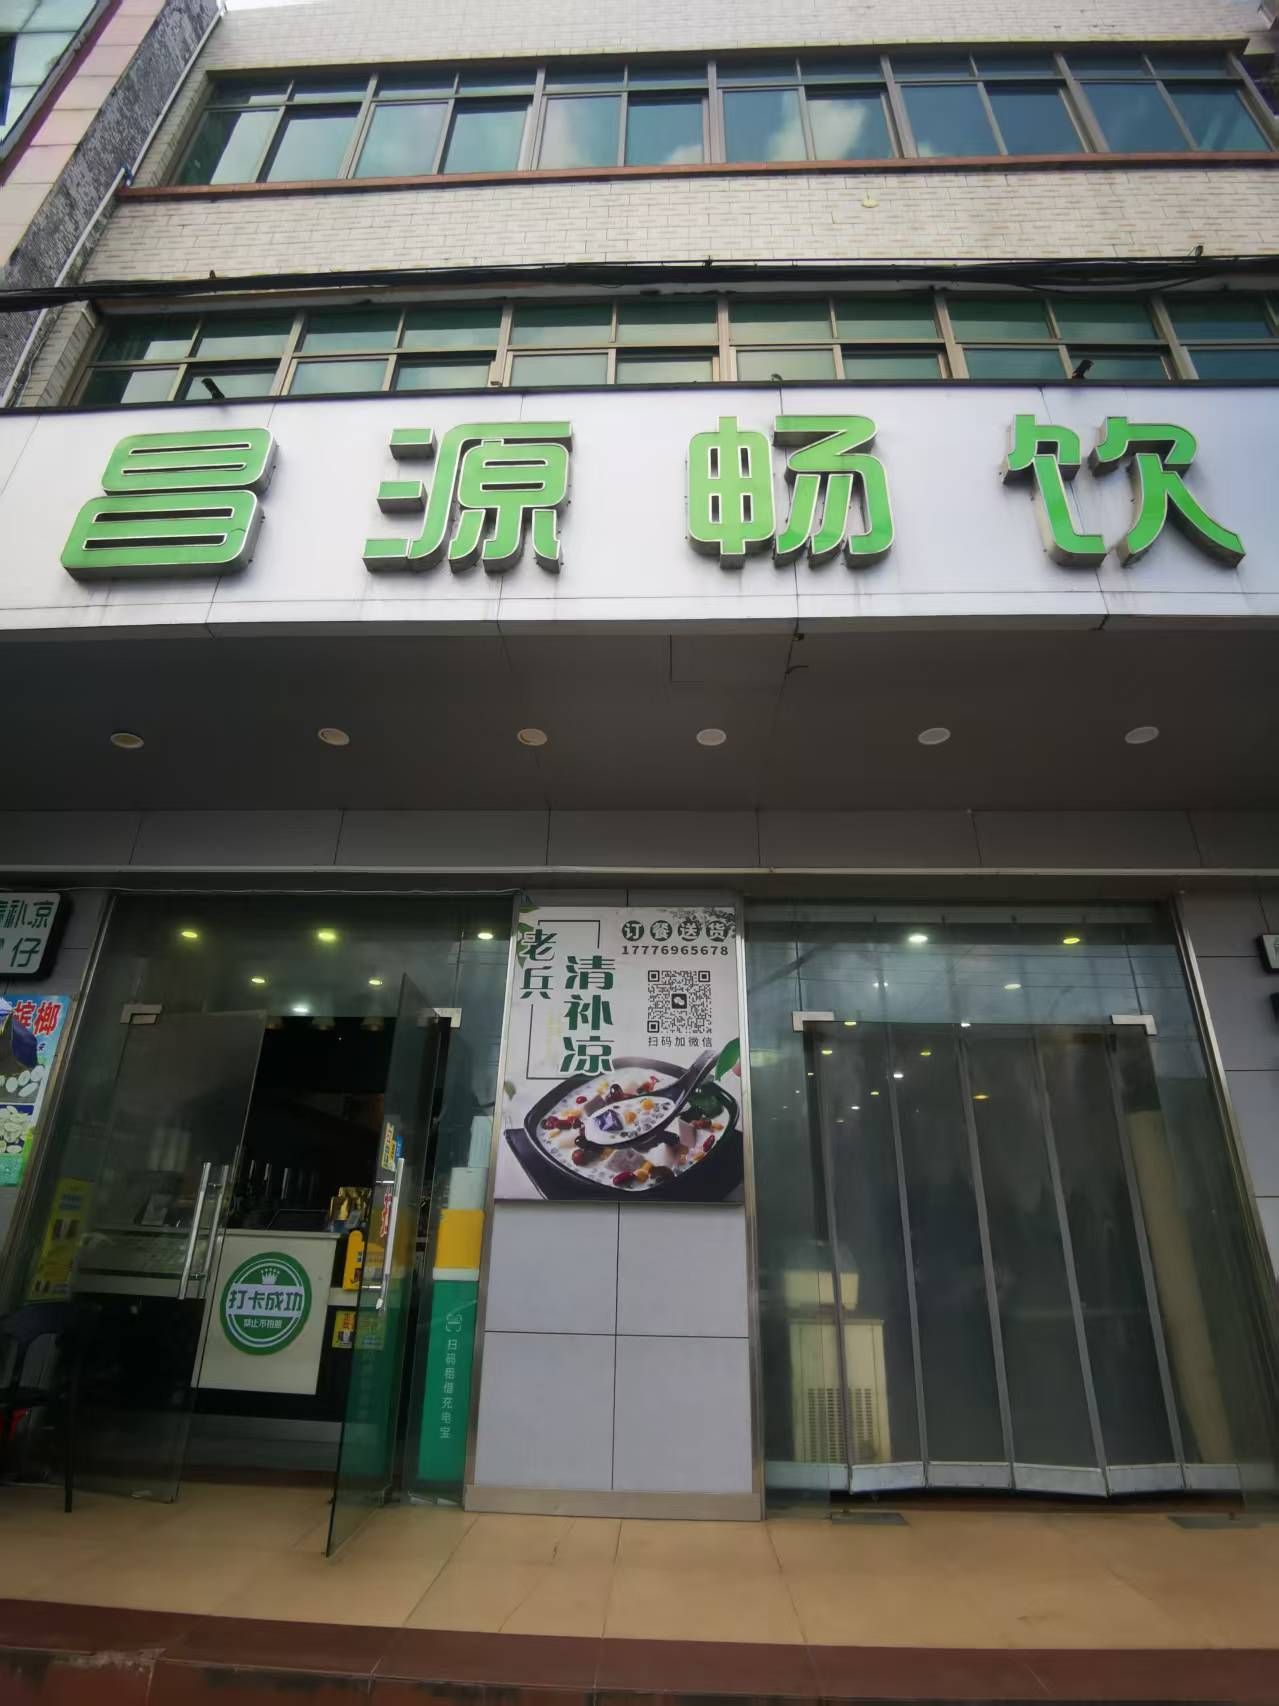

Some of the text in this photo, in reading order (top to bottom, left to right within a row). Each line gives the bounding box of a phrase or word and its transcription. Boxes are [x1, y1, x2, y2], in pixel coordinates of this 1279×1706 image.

[60, 414, 1246, 573] 昌源畅饮
[621, 920, 729, 942] 订餐送货
[621, 945, 729, 956] 17776965678
[520, 928, 557, 999] 老兵
[560, 955, 616, 1074] 清补凉
[647, 1036, 713, 1047] 扫码加微信
[228, 1288, 303, 1311] 打卡成功
